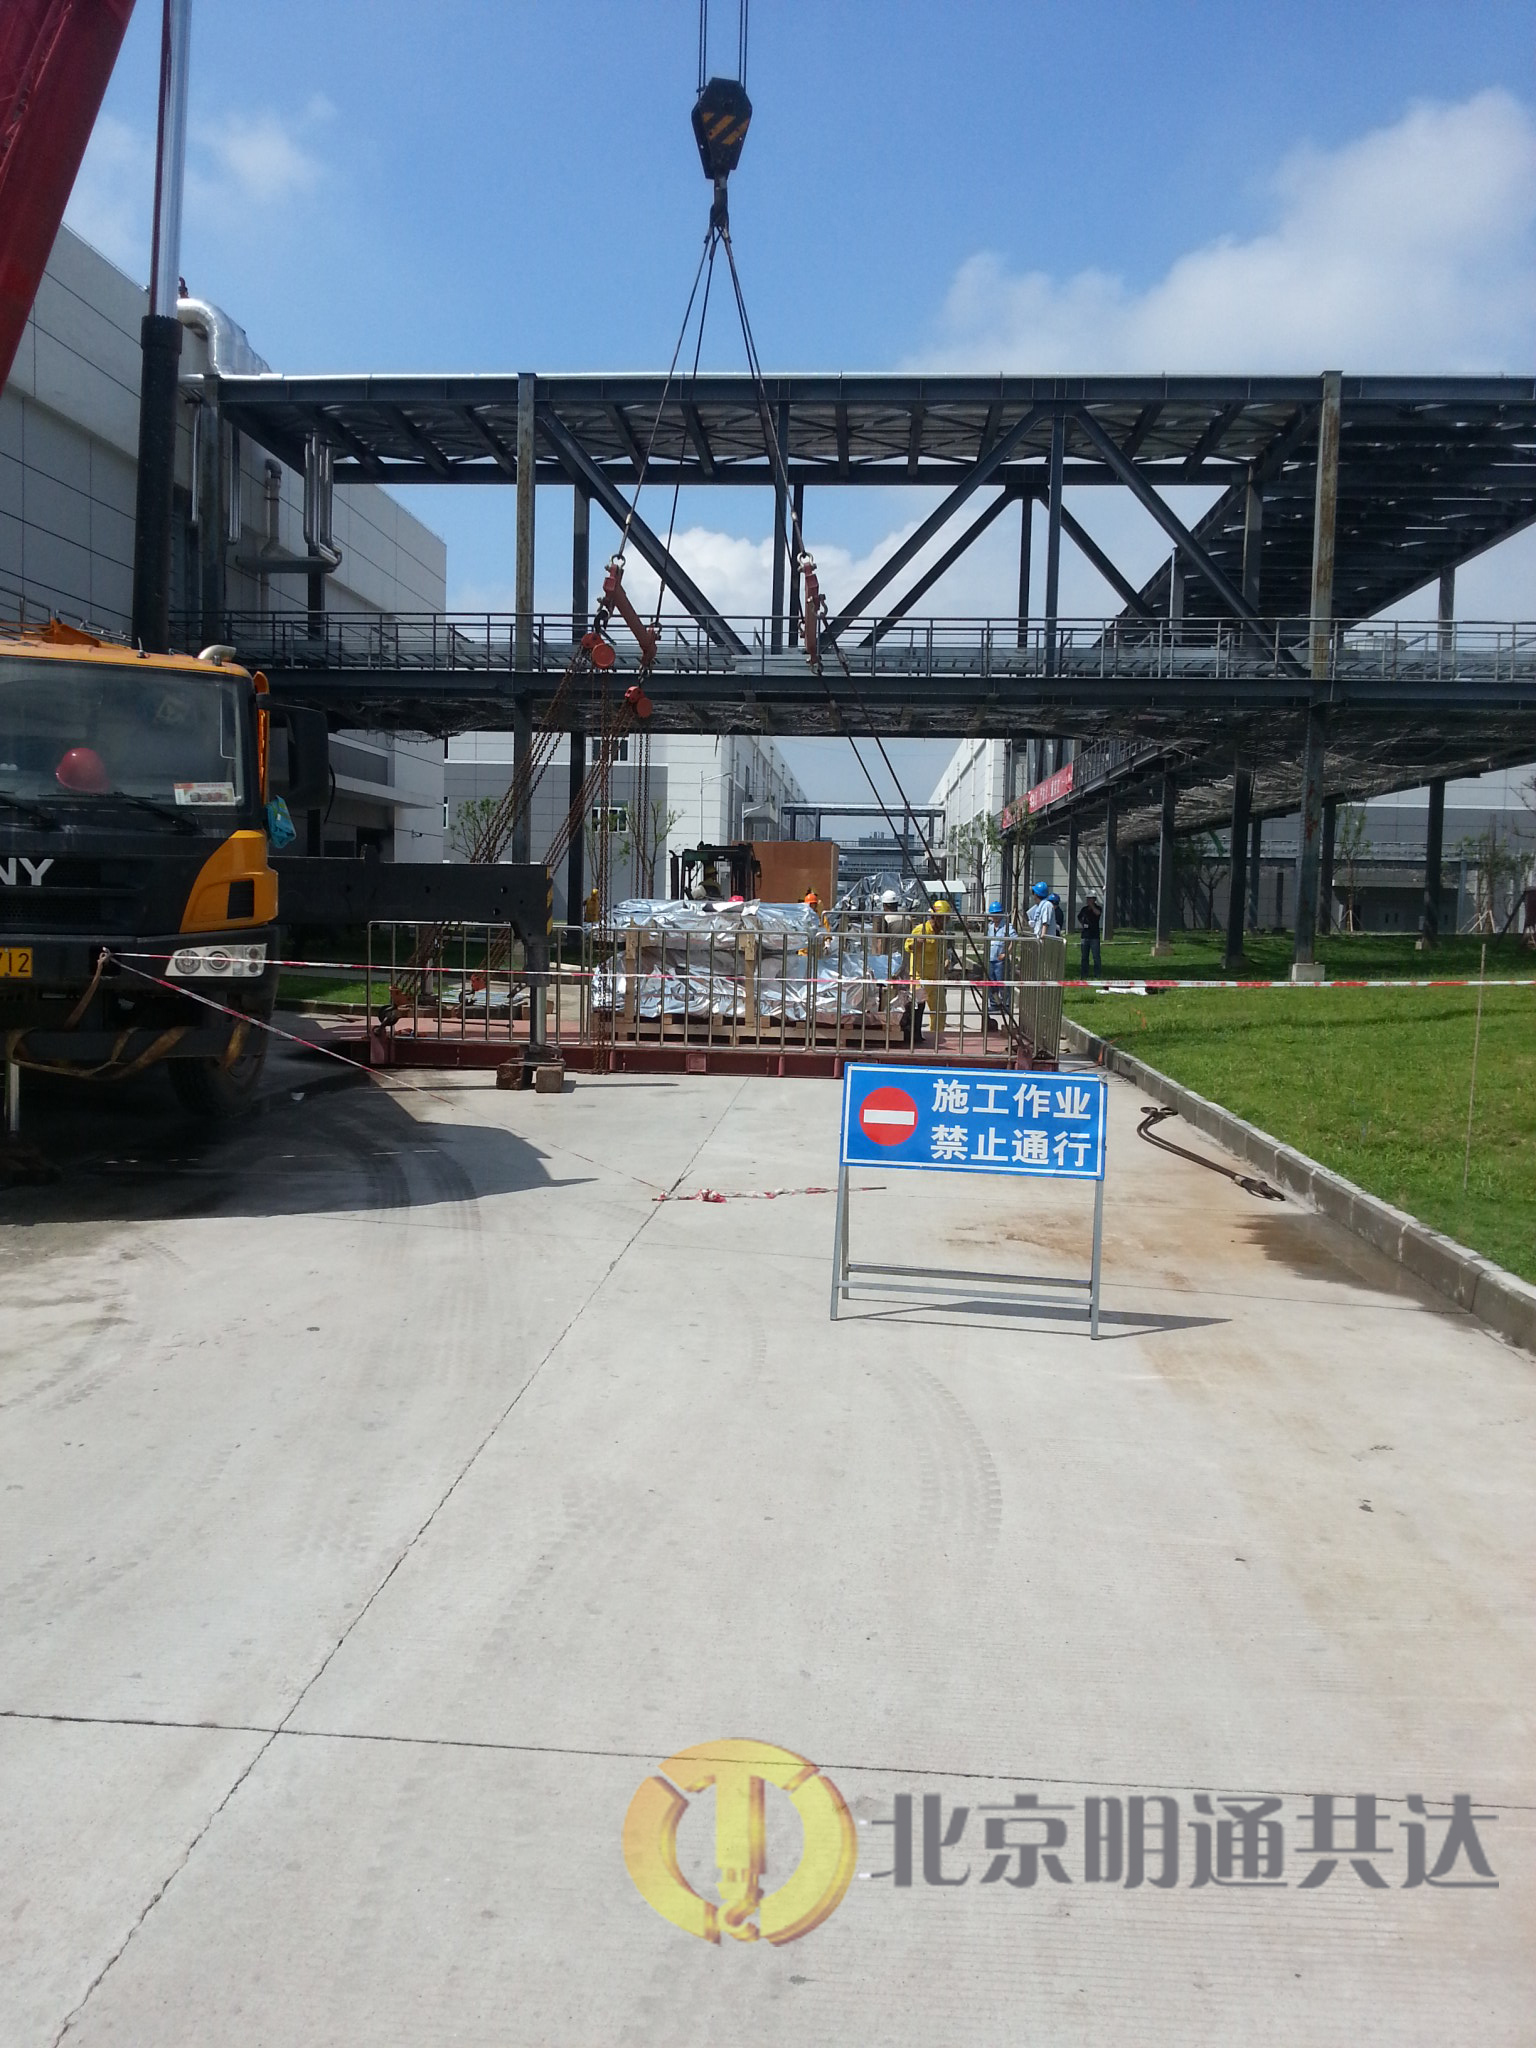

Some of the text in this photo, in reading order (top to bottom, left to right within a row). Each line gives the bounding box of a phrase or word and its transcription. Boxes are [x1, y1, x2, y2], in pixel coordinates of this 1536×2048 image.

[0, 952, 30, 973] 12
[931, 1078, 1091, 1120] 施工作业
[930, 1124, 1092, 1167] 禁止通行
